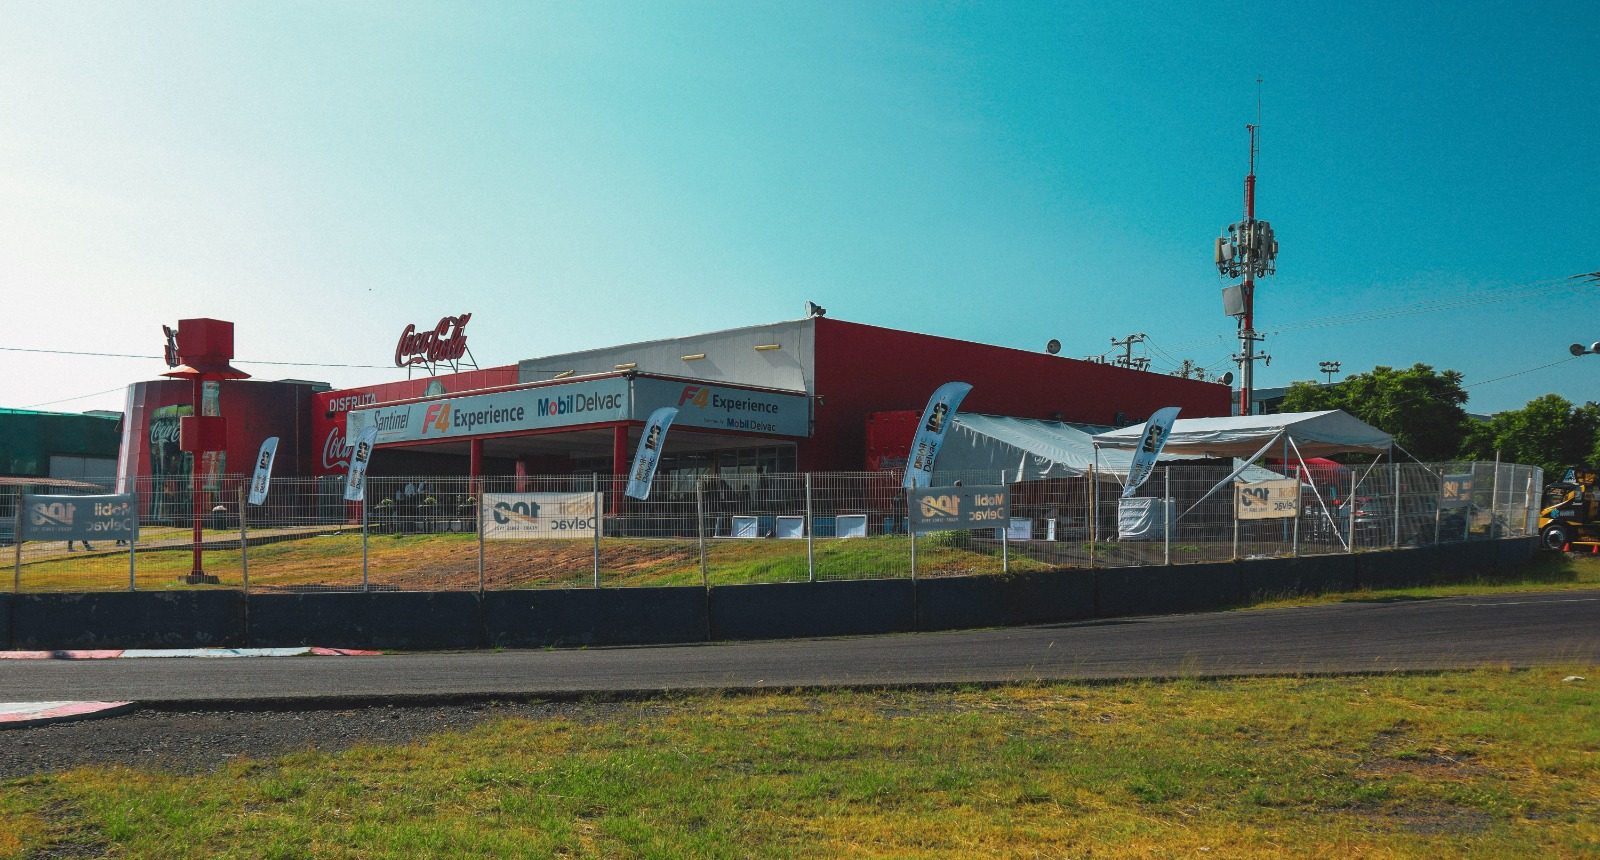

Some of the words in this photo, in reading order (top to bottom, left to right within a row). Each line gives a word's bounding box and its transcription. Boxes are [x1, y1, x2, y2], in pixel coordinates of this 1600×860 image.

[329, 393, 377, 412] DISFRUTA
[678, 385, 709, 410] F4
[712, 394, 779, 414] Experience
[374, 405, 411, 431] Santinel
[422, 403, 451, 434] F4
[454, 405, 525, 431] Experience
[538, 394, 573, 416] Mobil
[575, 391, 622, 413] Delvac
[727, 418, 749, 430] Mobil
